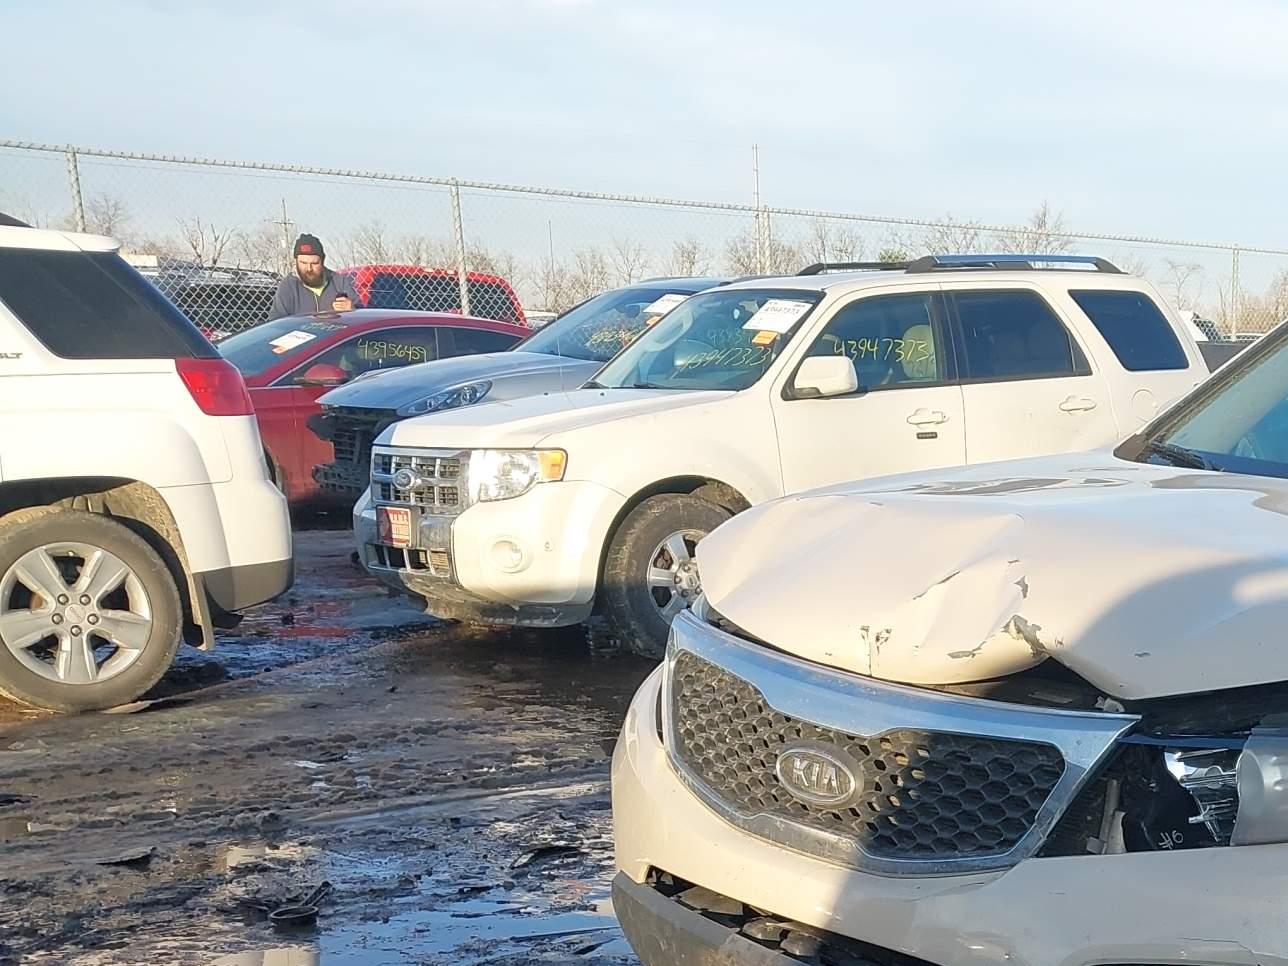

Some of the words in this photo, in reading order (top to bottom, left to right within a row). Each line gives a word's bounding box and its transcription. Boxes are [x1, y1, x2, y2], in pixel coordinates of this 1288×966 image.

[357, 338, 428, 363] 43956459
[833, 338, 930, 362] 43947373
[793, 757, 839, 795] KIA
